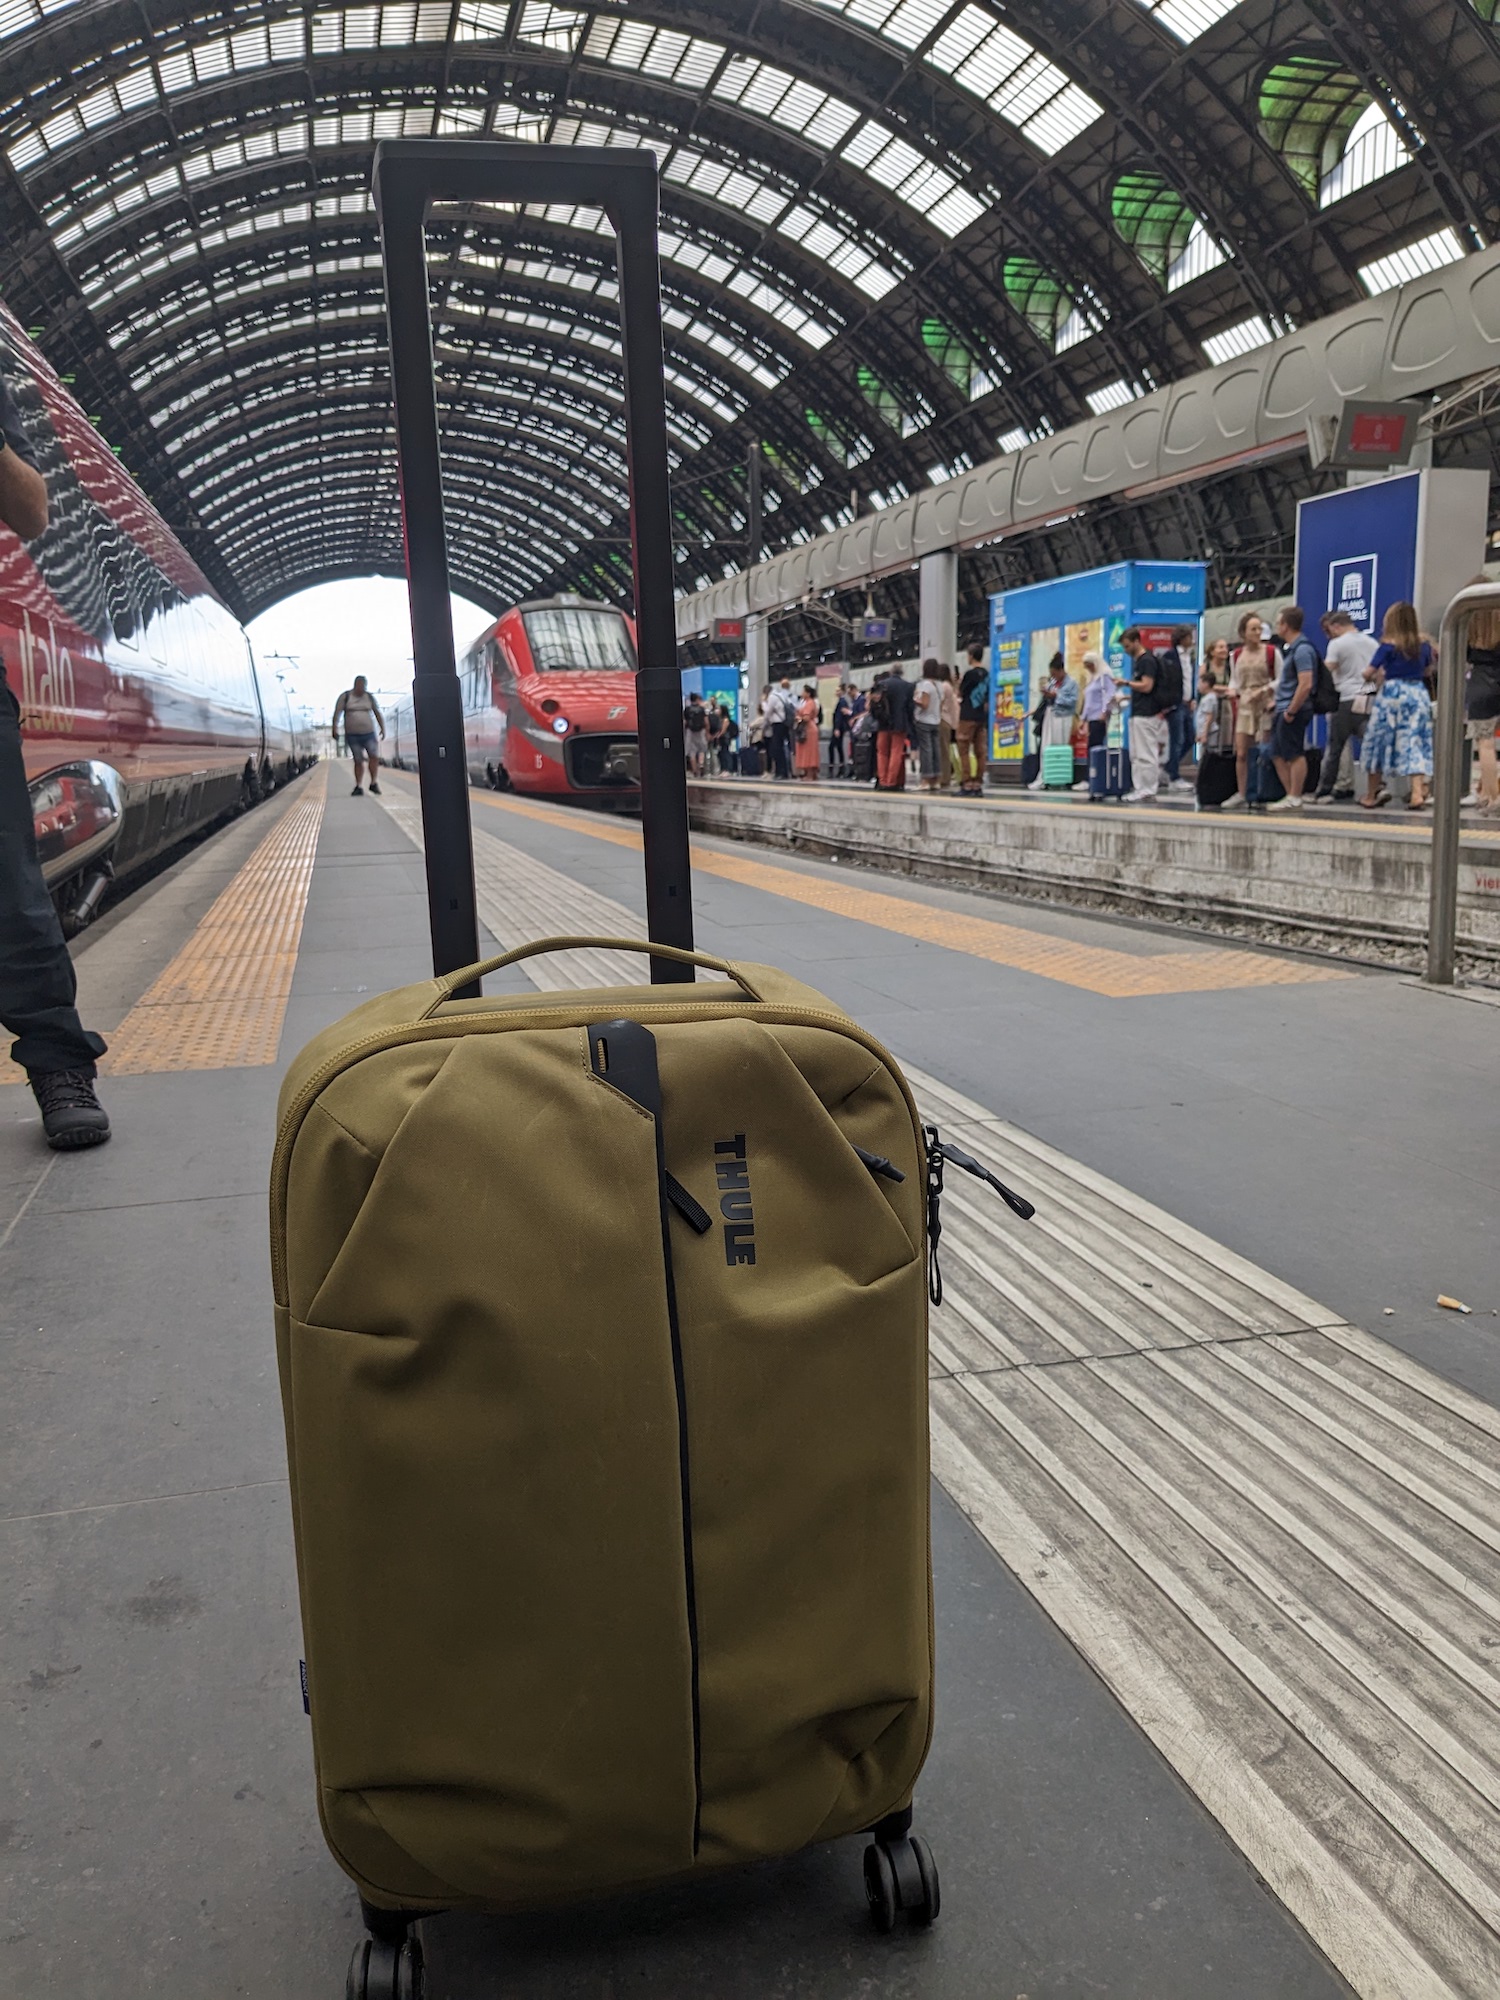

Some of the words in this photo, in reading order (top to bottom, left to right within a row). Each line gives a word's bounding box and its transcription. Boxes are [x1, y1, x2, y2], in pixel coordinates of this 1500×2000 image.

[1157, 582, 1174, 593] Self
[1175, 583, 1192, 594] Bar
[1337, 599, 1366, 612] MILANO
[714, 1134, 756, 1267] THULE
